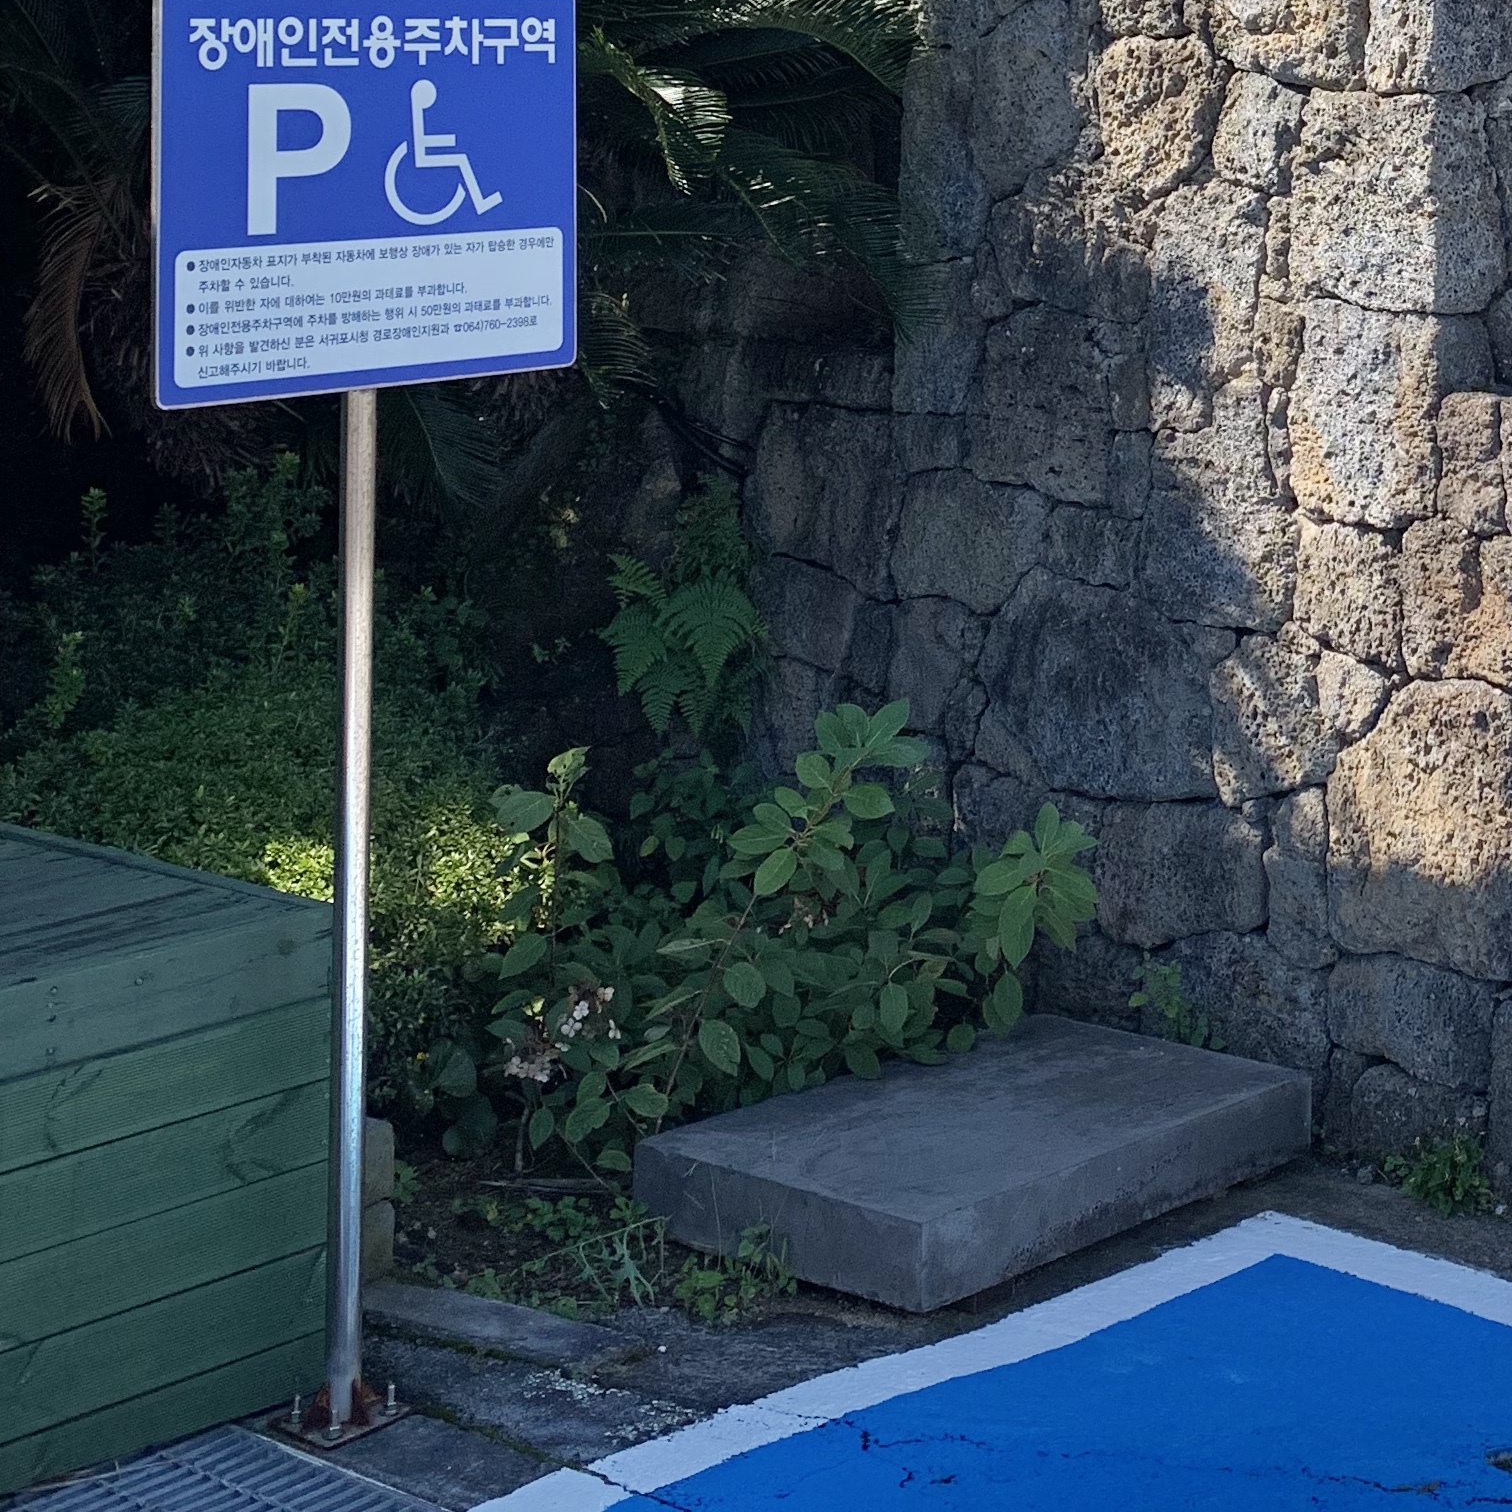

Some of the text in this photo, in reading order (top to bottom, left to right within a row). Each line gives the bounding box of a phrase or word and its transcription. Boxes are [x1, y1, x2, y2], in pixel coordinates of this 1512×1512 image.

[189, 15, 556, 70] 장애인전용주차구역
[247, 83, 352, 236] P
[199, 236, 554, 272] 장애인자동차 표지가 부착된 자동차에 보행상 장애가 있는 자가 탑승한 경우에만
[199, 275, 294, 293] 주차할 수 있습니다.
[199, 282, 467, 315] 이를 위반한 자에 대하여는 10만원의 과태료를 부과합니다.
[199, 295, 552, 337] 장애인전용주차구역에 주차를 방해하는 행위 시 50만원의 과태료를 부과합니다.
[199, 344, 208, 358] 위
[213, 341, 245, 356] 사항을
[249, 337, 290, 353] 발견하신
[318, 329, 370, 347] 서귀포시청
[198, 357, 310, 379] 신고해주시기 바랍니다.
